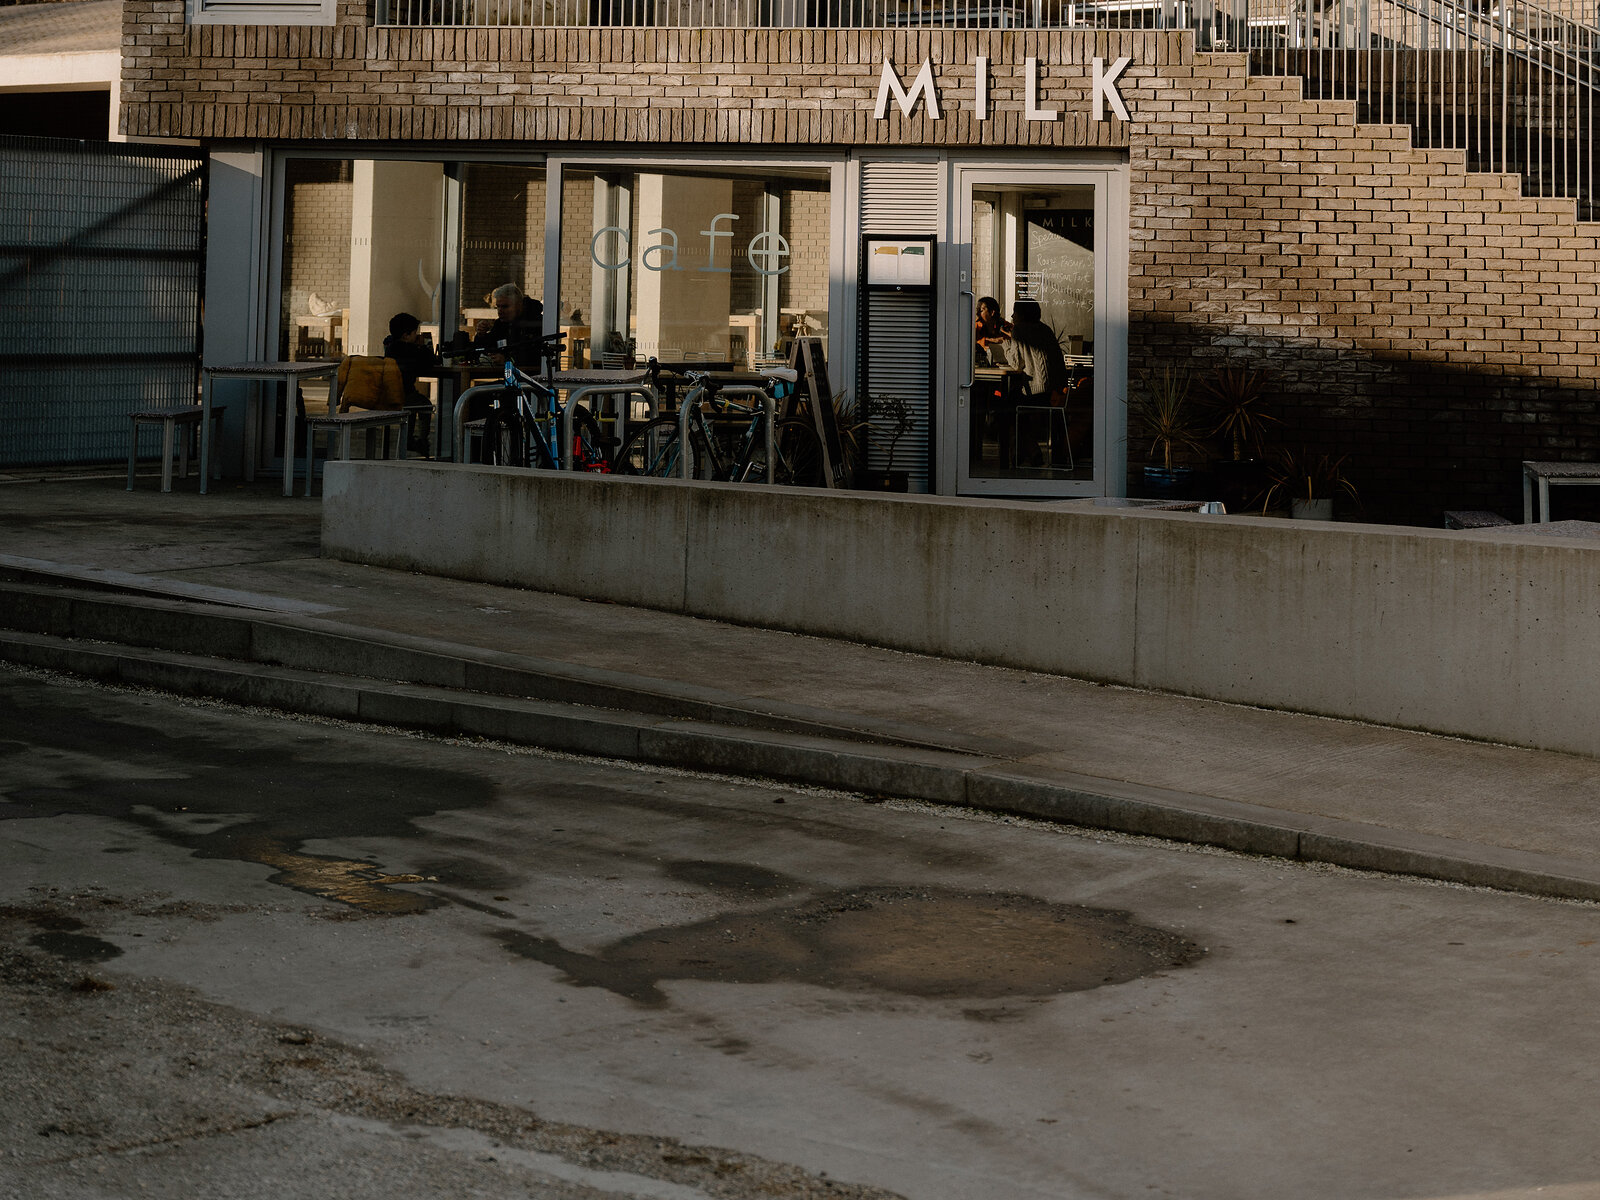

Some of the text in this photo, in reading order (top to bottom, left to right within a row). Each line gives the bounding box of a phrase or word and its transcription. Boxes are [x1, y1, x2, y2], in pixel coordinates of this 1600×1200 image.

[873, 56, 1133, 121] MILK
[591, 213, 791, 275] cafe
[1042, 216, 1093, 228] MILK
